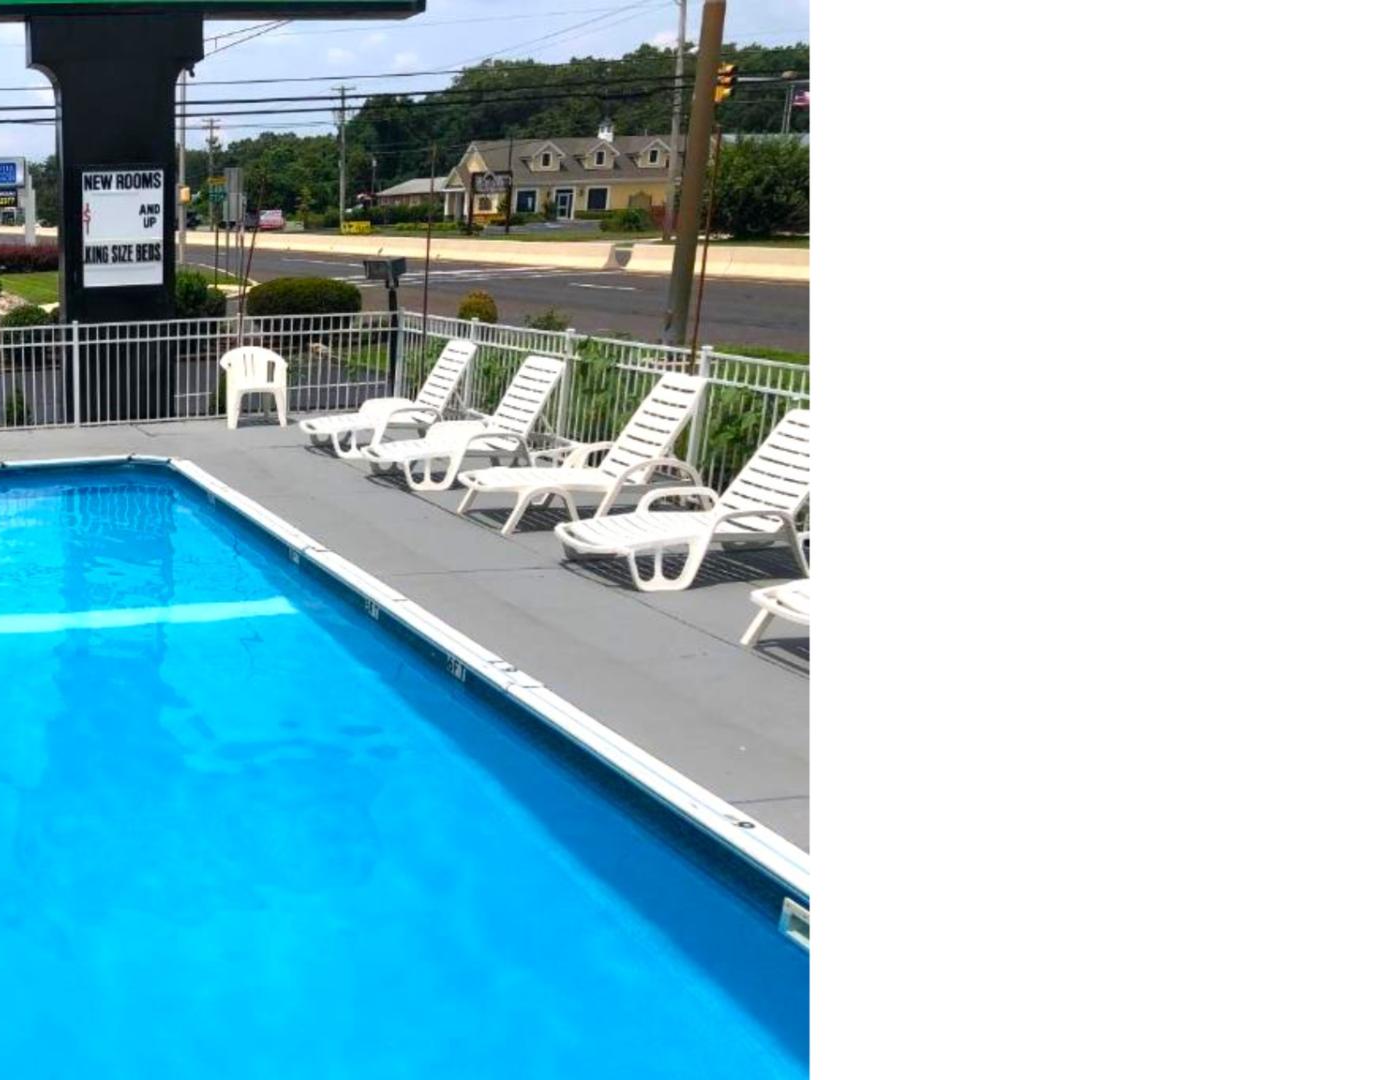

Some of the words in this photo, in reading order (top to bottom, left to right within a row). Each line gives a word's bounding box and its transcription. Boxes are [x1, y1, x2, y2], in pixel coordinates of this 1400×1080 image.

[84, 174, 112, 191] NEW
[116, 172, 161, 190] ROOMS
[139, 204, 160, 215] AND
[143, 217, 157, 228] UP
[85, 245, 108, 264] KING
[112, 244, 133, 262] SIZE
[135, 243, 161, 261] BEDS
